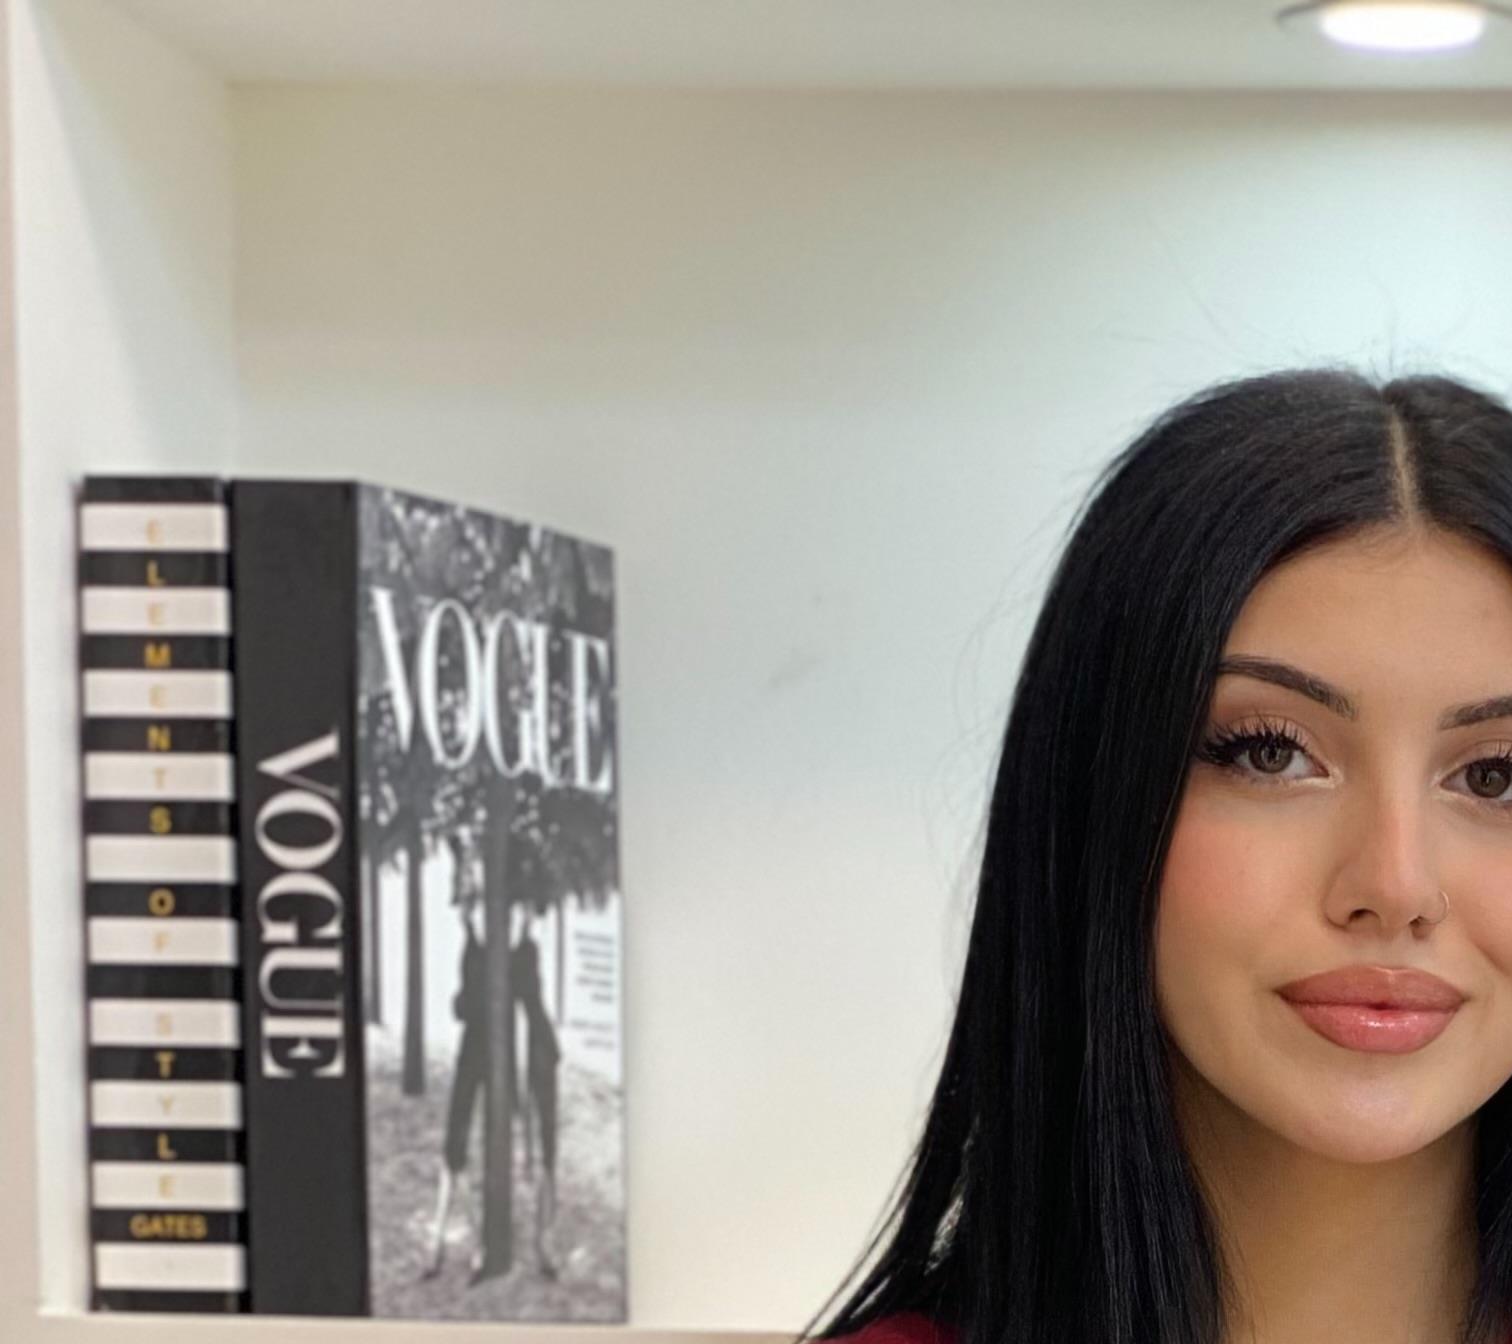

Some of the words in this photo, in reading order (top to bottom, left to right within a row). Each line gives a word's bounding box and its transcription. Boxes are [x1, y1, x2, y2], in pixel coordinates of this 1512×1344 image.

[144, 518, 171, 834] ELEMENTS
[370, 584, 612, 796] VOGUE
[149, 889, 175, 953] OF
[255, 724, 344, 1078] VOGUE
[154, 1013, 178, 1199] STYLE
[130, 1213, 208, 1240] GATES
